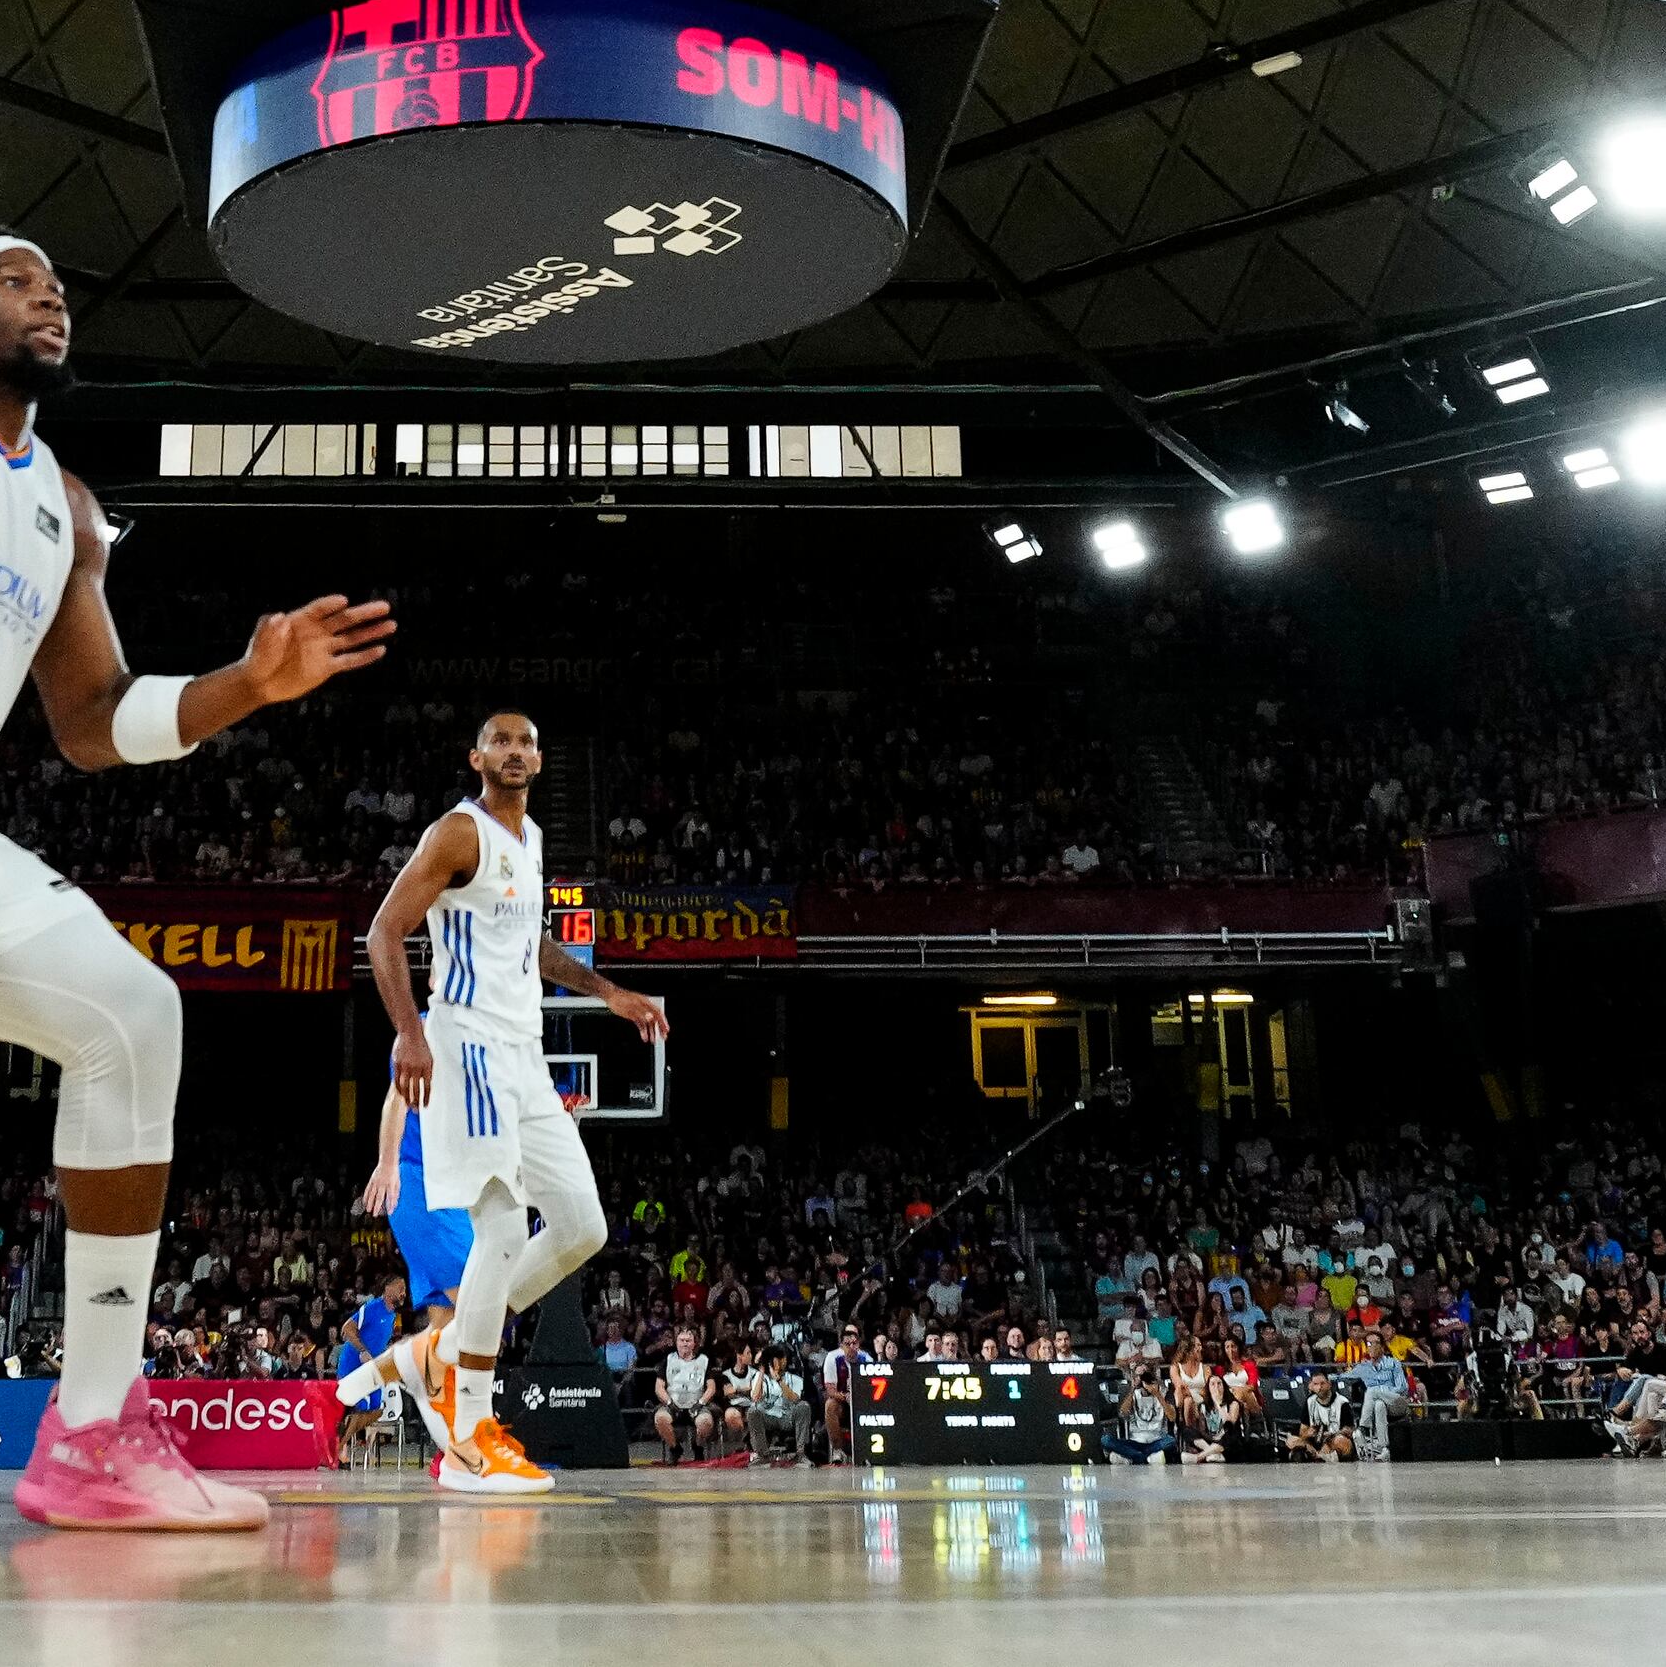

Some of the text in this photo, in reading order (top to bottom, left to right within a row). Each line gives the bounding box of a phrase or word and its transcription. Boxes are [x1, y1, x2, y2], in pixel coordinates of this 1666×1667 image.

[561, 911, 591, 943] 16
[870, 1376, 1079, 1401] 7 7:45 1 4
[870, 1432, 1082, 1453] 2 0
